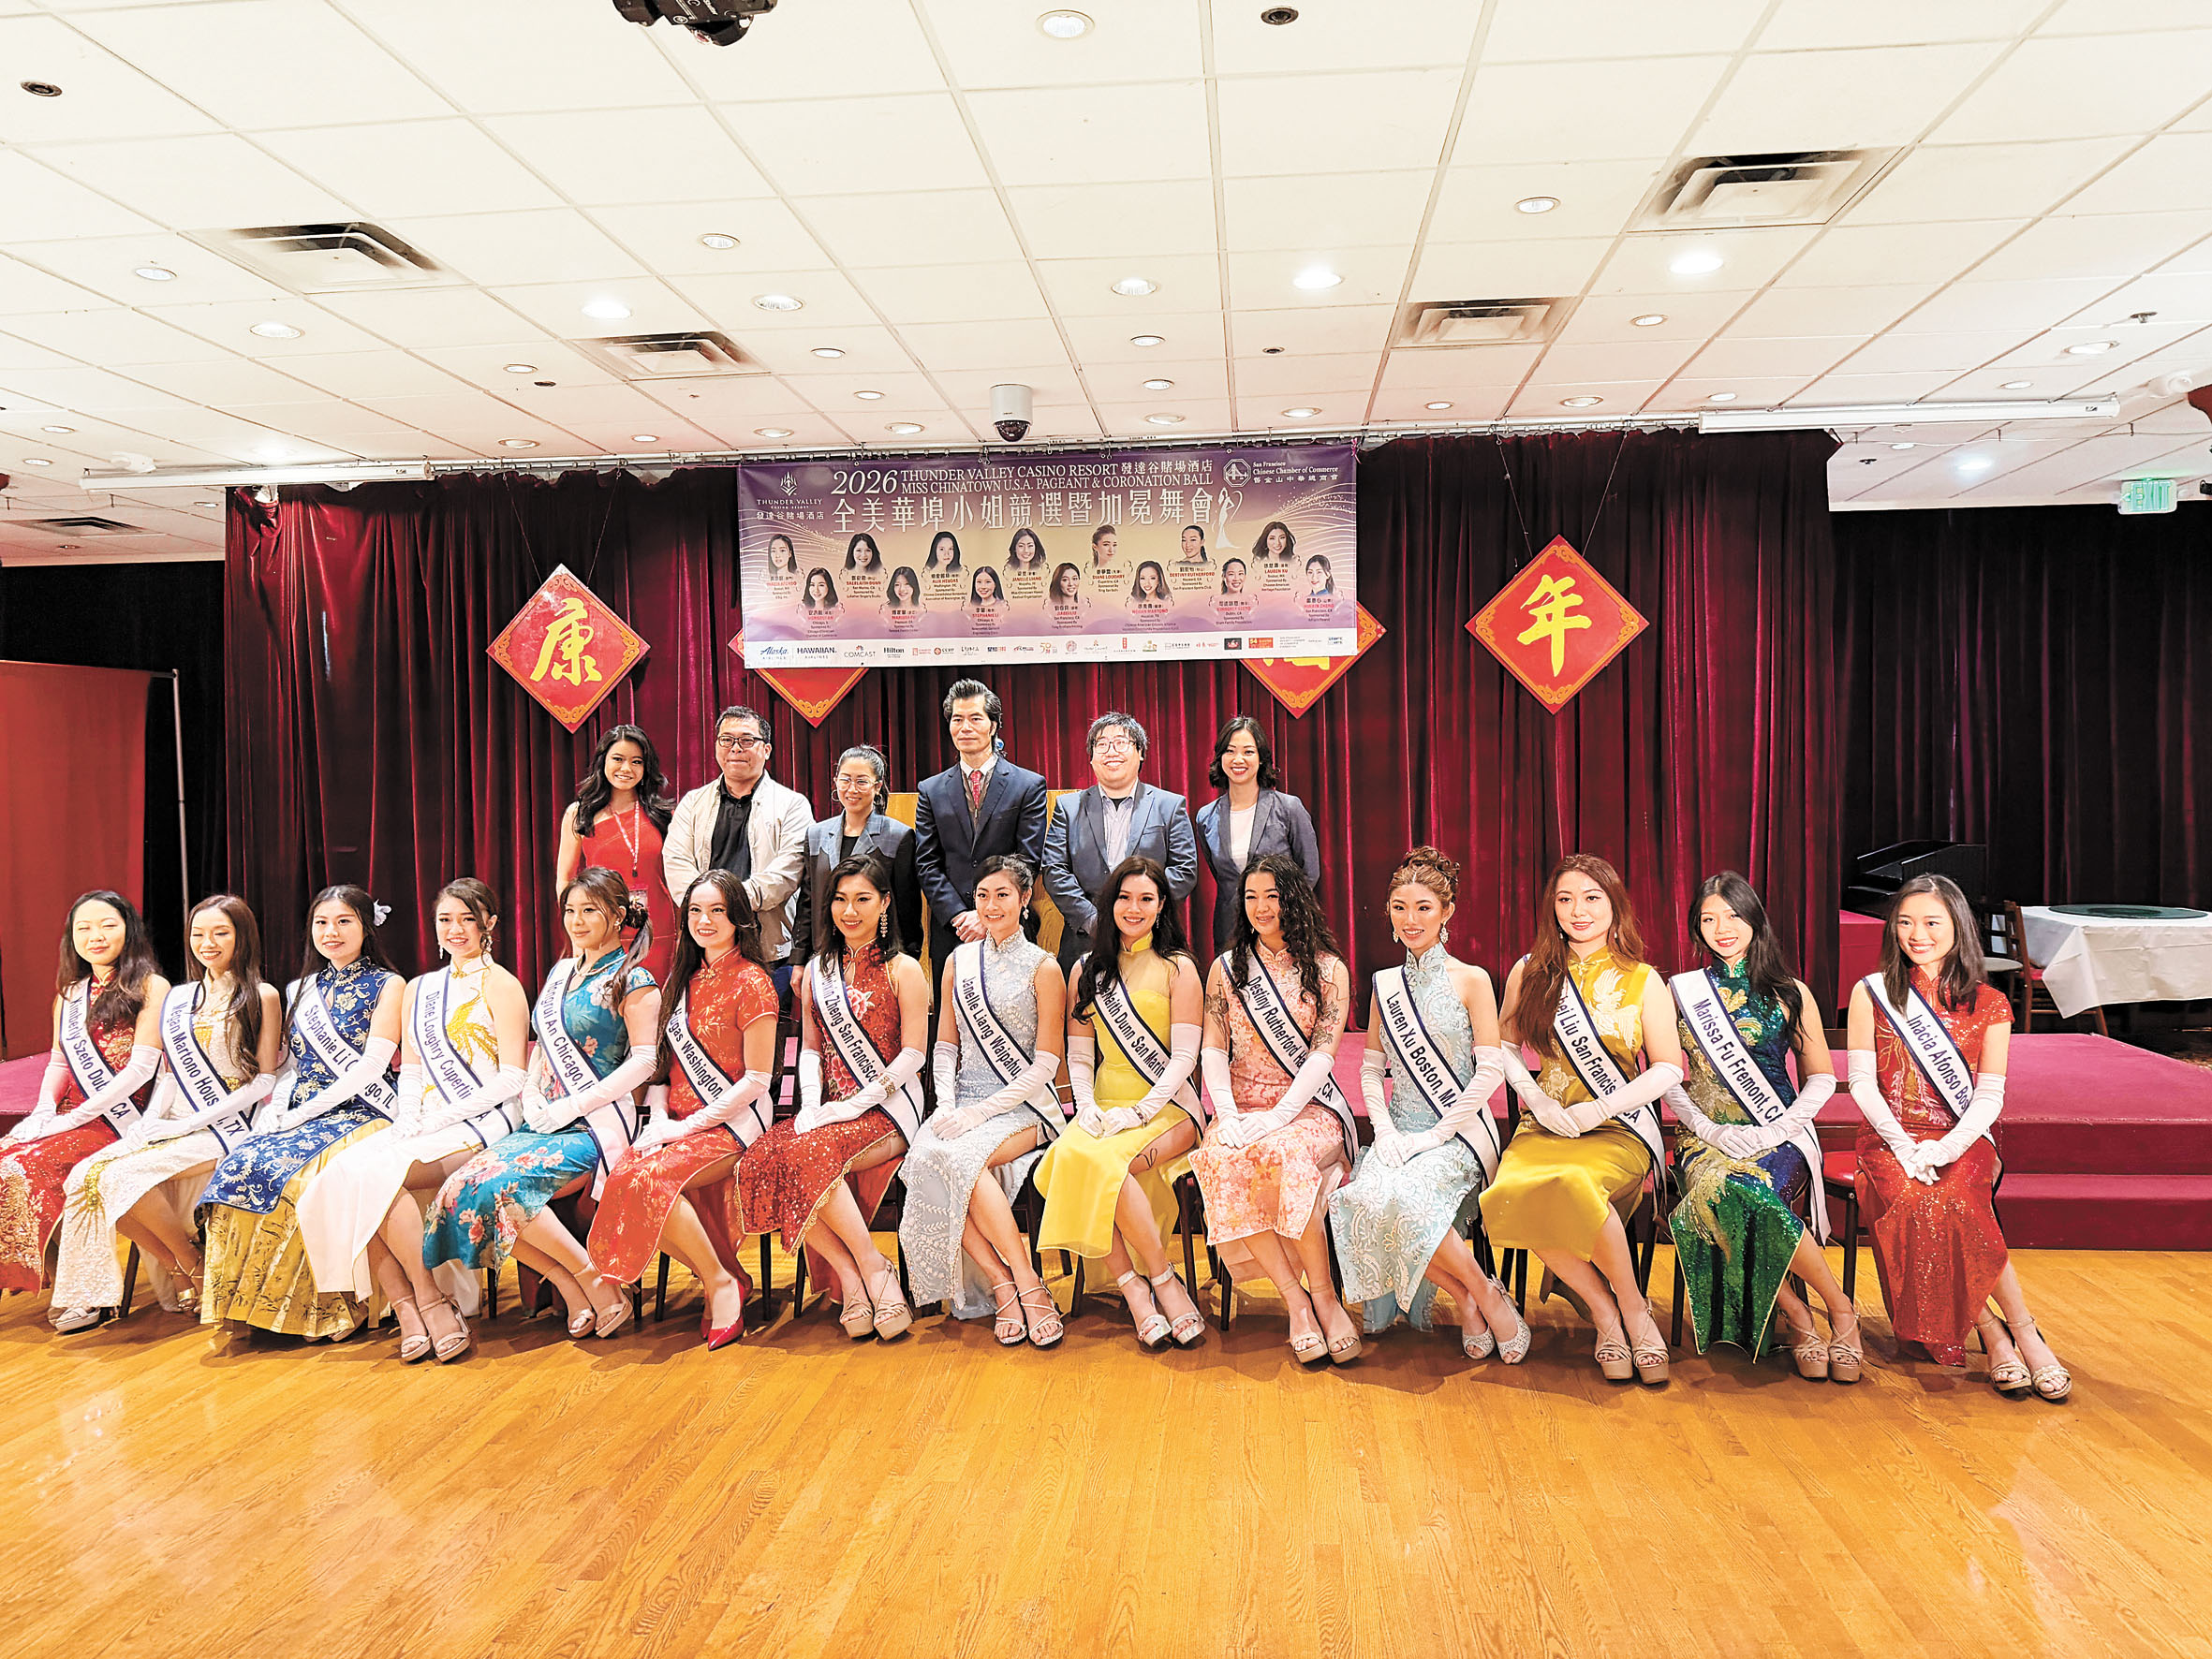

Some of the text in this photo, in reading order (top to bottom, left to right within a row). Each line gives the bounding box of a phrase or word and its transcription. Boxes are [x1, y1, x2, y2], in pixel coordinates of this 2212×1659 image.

[831, 469, 897, 494] 2026
[901, 463, 1118, 481] THUNDER VALLEY CASINO RESORT
[901, 474, 1213, 494] MISS CHINATOWN U.S.A. PAGEANT & CORONATION BALL
[2131, 481, 2171, 511] EXIT
[831, 488, 1214, 534] 全美華埠小姐競選暨加冕舞會
[530, 597, 602, 685] 康
[1516, 573, 1592, 677] 年
[760, 646, 788, 655] Alaska
[66, 996, 82, 1041] Kimberly
[424, 991, 440, 1019] Diane
[824, 995, 845, 1027] Zheng
[838, 1023, 854, 1045] San
[962, 976, 1022, 1081] Janelle Liang Waipahu,
[73, 1039, 94, 1070] Szeto
[304, 1005, 337, 1054] Stephanie
[332, 1048, 351, 1065] Li
[382, 1094, 394, 1109] IL
[423, 1017, 444, 1060] Loughry
[545, 1019, 557, 1036] An
[553, 1036, 584, 1087] Chicago,
[1114, 1011, 1135, 1040] Dunn
[1131, 1035, 1149, 1058] San
[1248, 976, 1270, 1012] Destiny
[1262, 1007, 1298, 1059] Rutherford
[1321, 1082, 1334, 1102] CA
[1386, 991, 1408, 1032] Lauren
[1400, 1028, 1416, 1050] Xu
[1409, 1045, 1443, 1095] Boston,
[1559, 1012, 1579, 1035] Liu
[1571, 1035, 1592, 1061] San
[1692, 998, 1724, 1044] Marissa
[1716, 1041, 1733, 1062] Fu
[1727, 1058, 1770, 1114] Fremont,
[1907, 1014, 1937, 1050] Inácia
[1927, 1050, 1961, 1090] Afonso
[172, 1032, 201, 1079] Martono
[228, 1119, 244, 1137] TX
[681, 1040, 723, 1103] Washington,
[110, 1102, 131, 1120] CA
